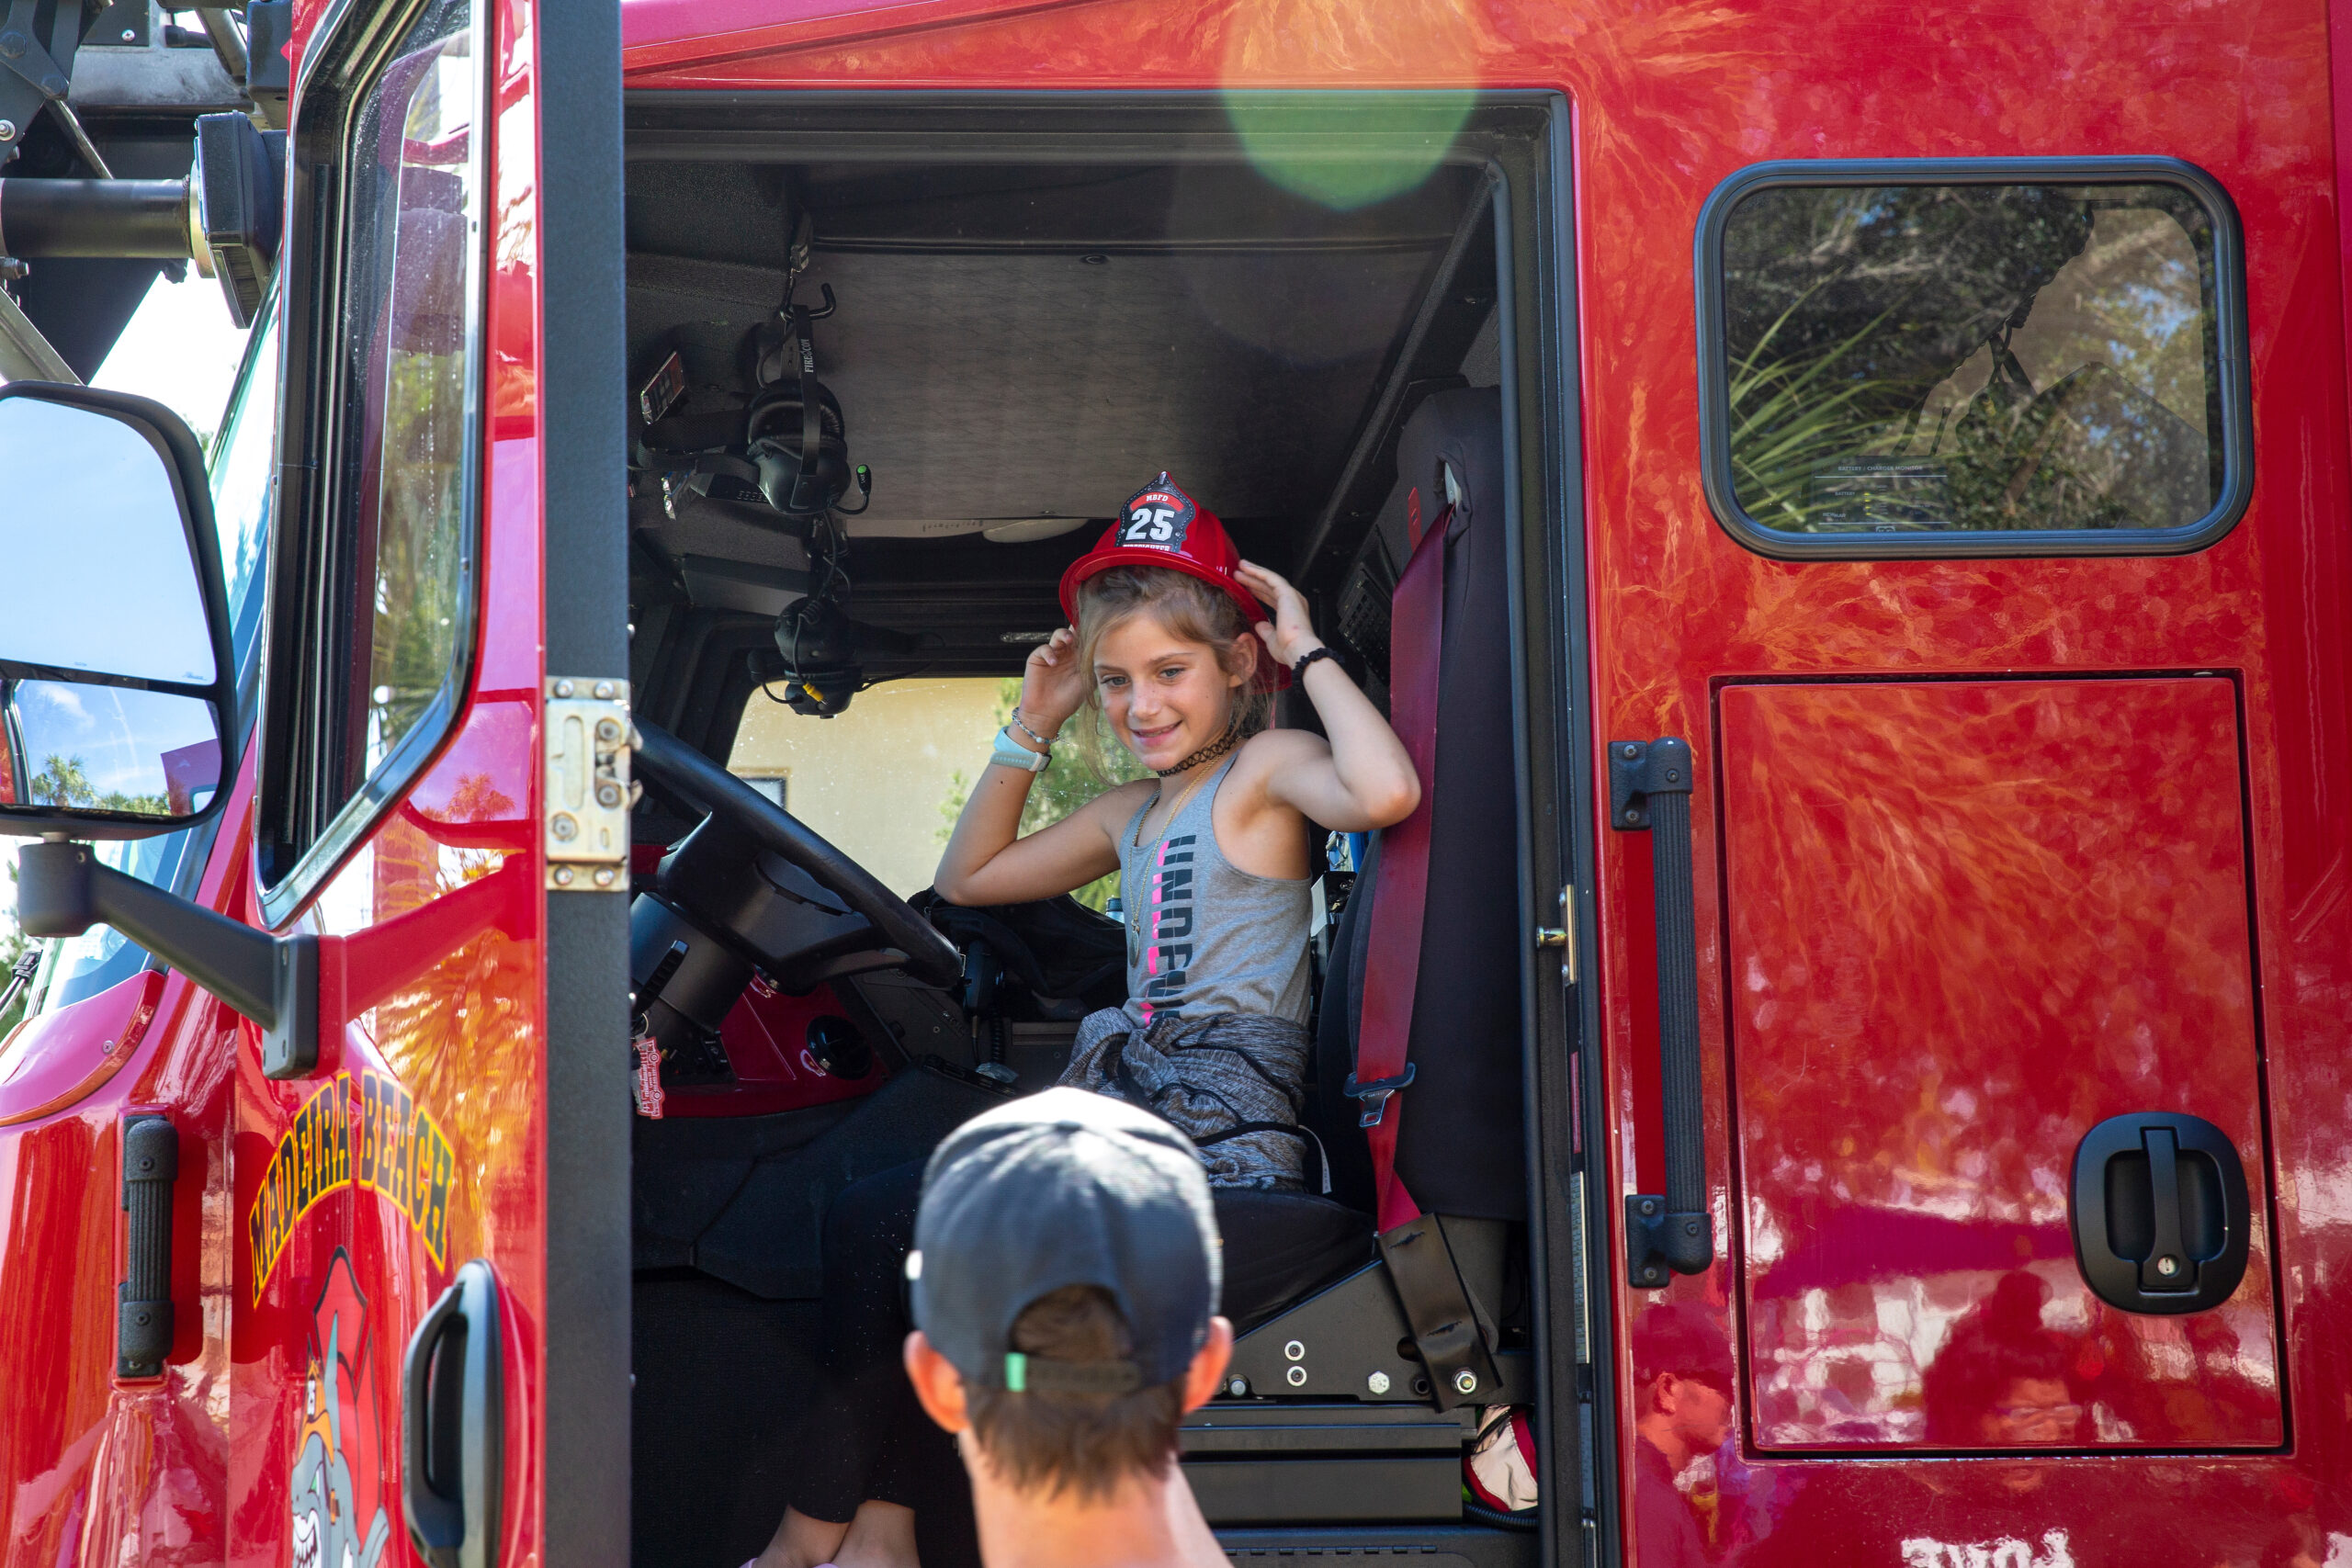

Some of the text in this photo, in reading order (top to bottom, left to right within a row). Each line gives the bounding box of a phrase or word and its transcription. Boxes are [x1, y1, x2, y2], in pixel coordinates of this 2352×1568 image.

[1125, 508, 1175, 541] 25
[249, 1066, 456, 1309] MADEIRA BEACH
